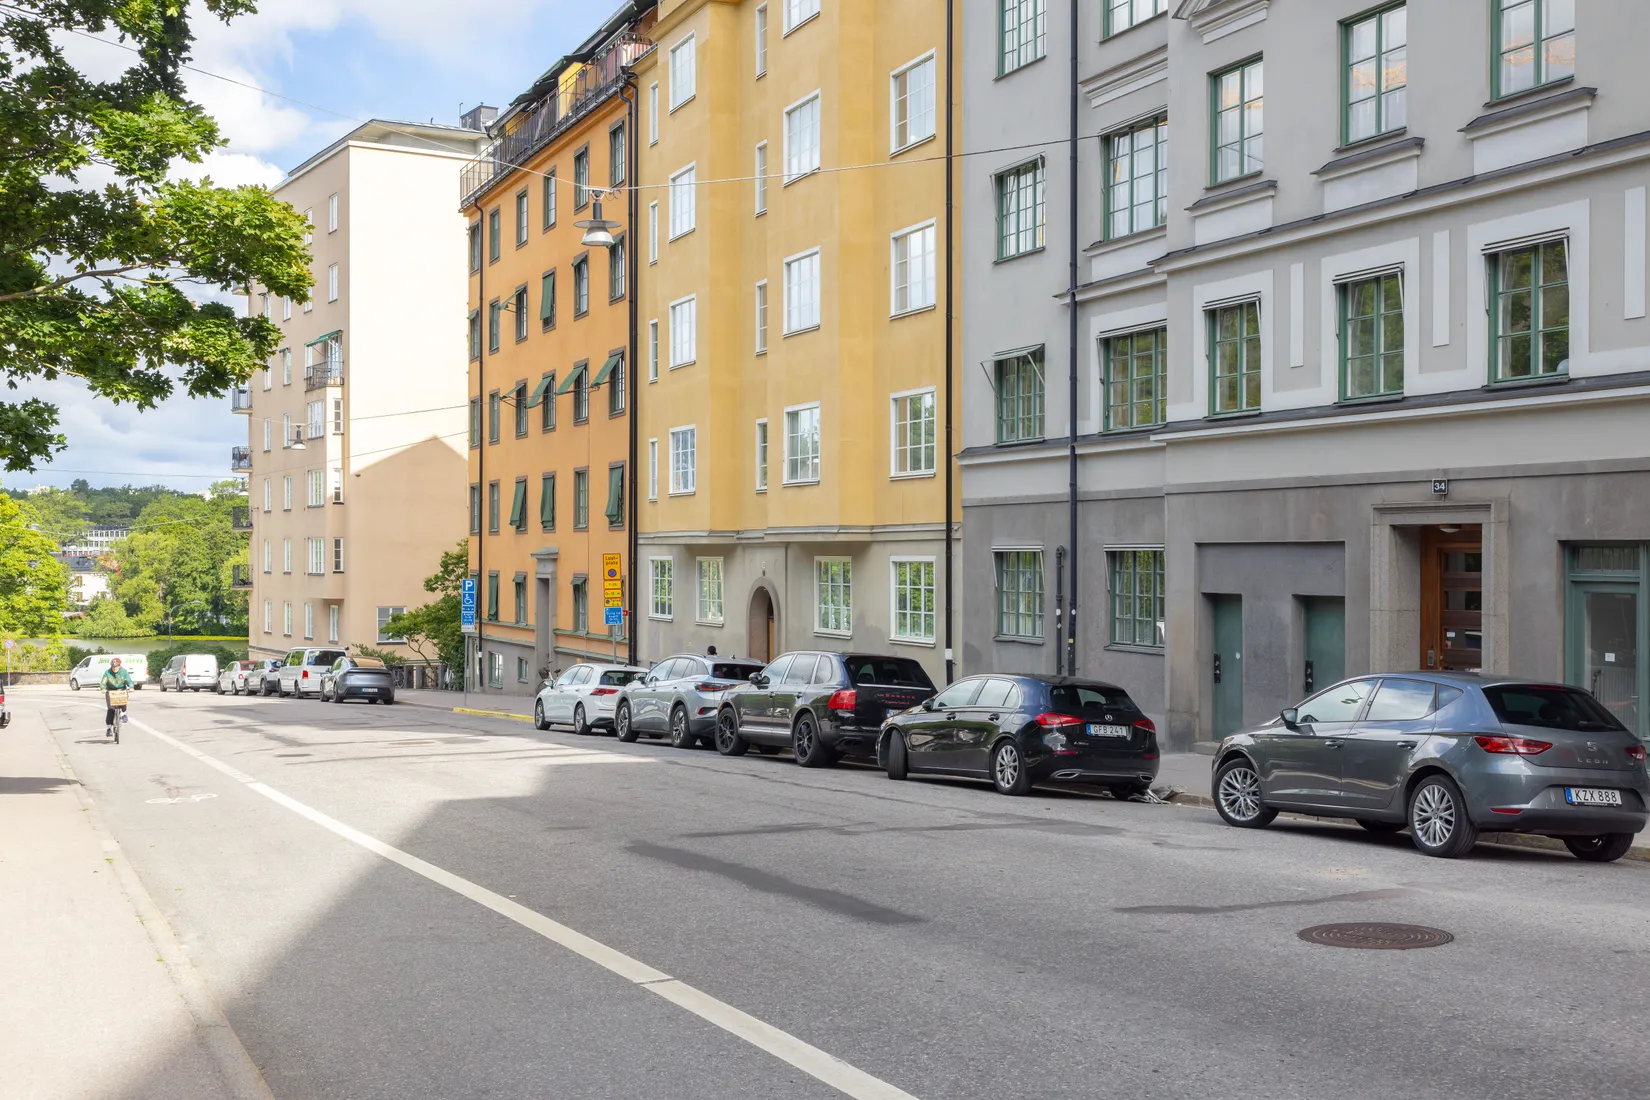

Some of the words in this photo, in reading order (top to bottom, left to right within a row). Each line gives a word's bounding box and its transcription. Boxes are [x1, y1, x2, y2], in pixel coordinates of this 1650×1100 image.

[1434, 482, 1446, 491] 34
[465, 580, 473, 591] P
[1093, 725, 1108, 734] GFB
[1574, 790, 1596, 801] KZX
[1598, 791, 1617, 802] 888
